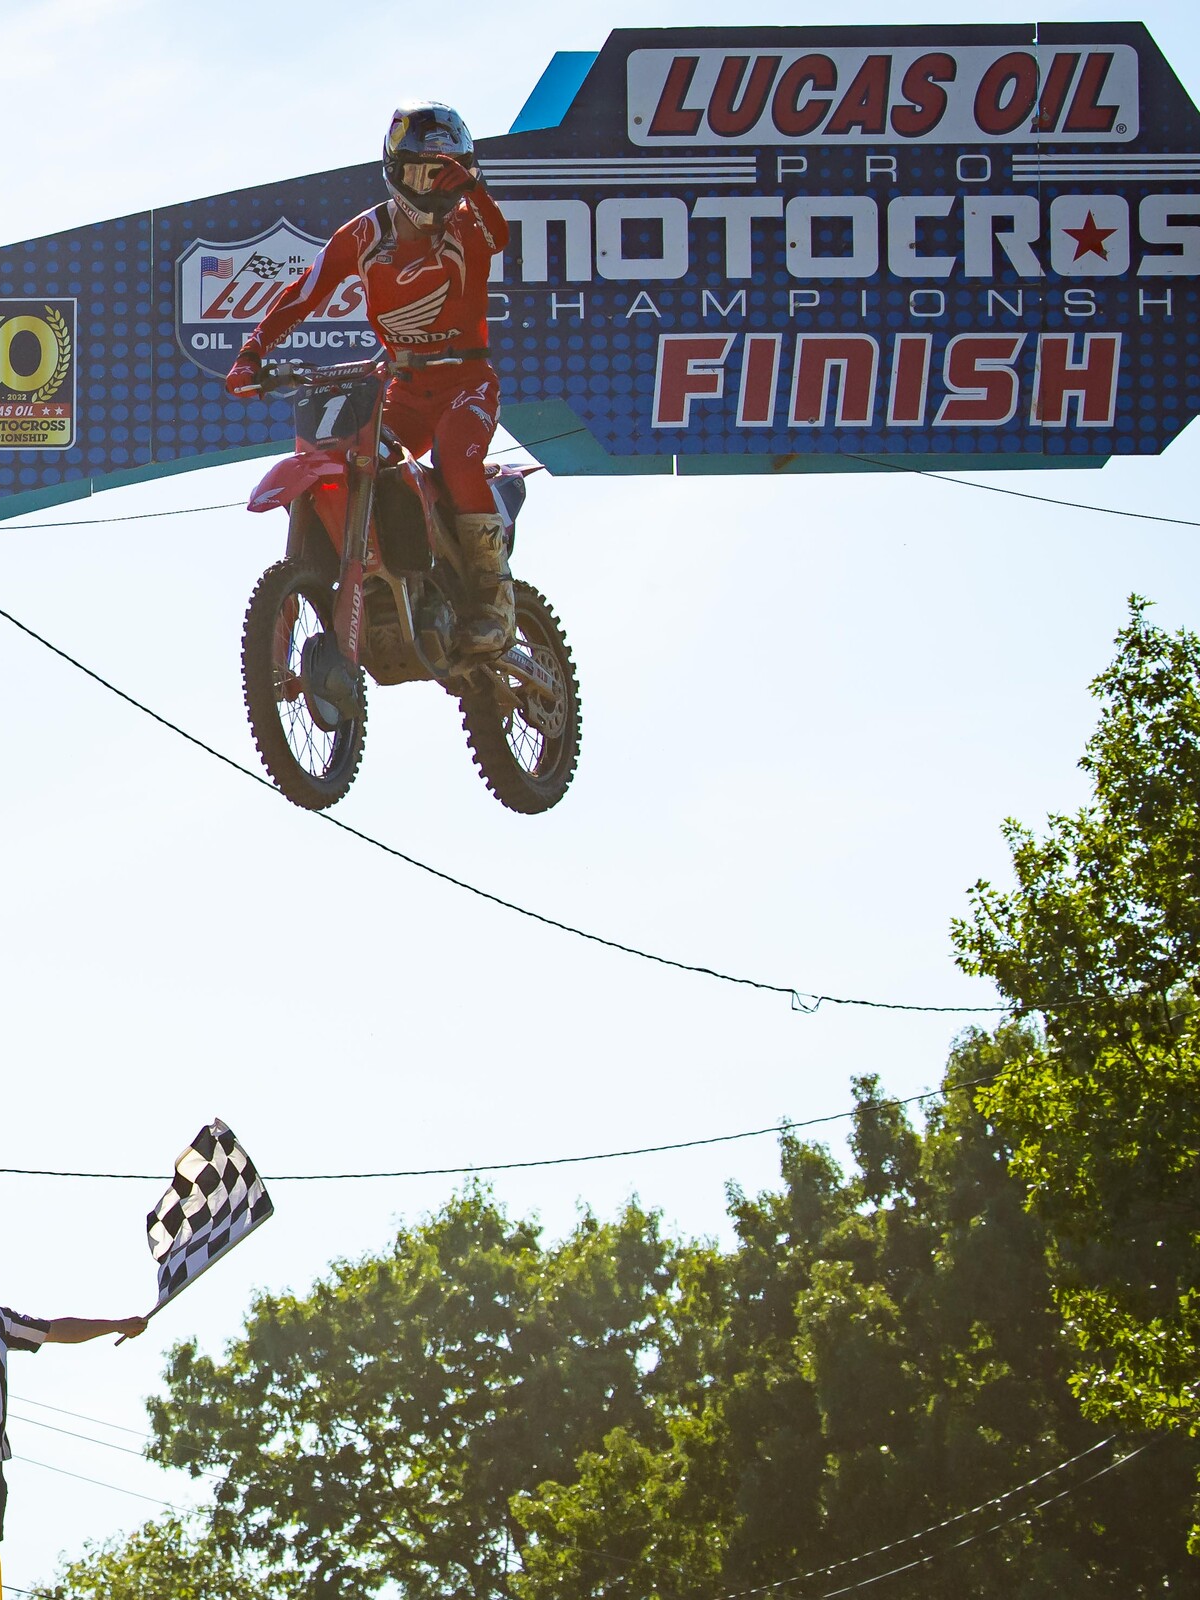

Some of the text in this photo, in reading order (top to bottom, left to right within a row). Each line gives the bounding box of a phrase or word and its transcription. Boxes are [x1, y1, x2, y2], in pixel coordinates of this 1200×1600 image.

[647, 52, 1120, 138] LUCAS OIL
[777, 154, 991, 183] PRO
[191, 332, 232, 350] OIL
[384, 328, 462, 344] HONDA
[651, 333, 1122, 428] FINISH
[7, 393, 27, 401] 2022
[14, 406, 34, 417] OIL
[315, 395, 347, 440] 1
[349, 583, 360, 653] DUNLOP
